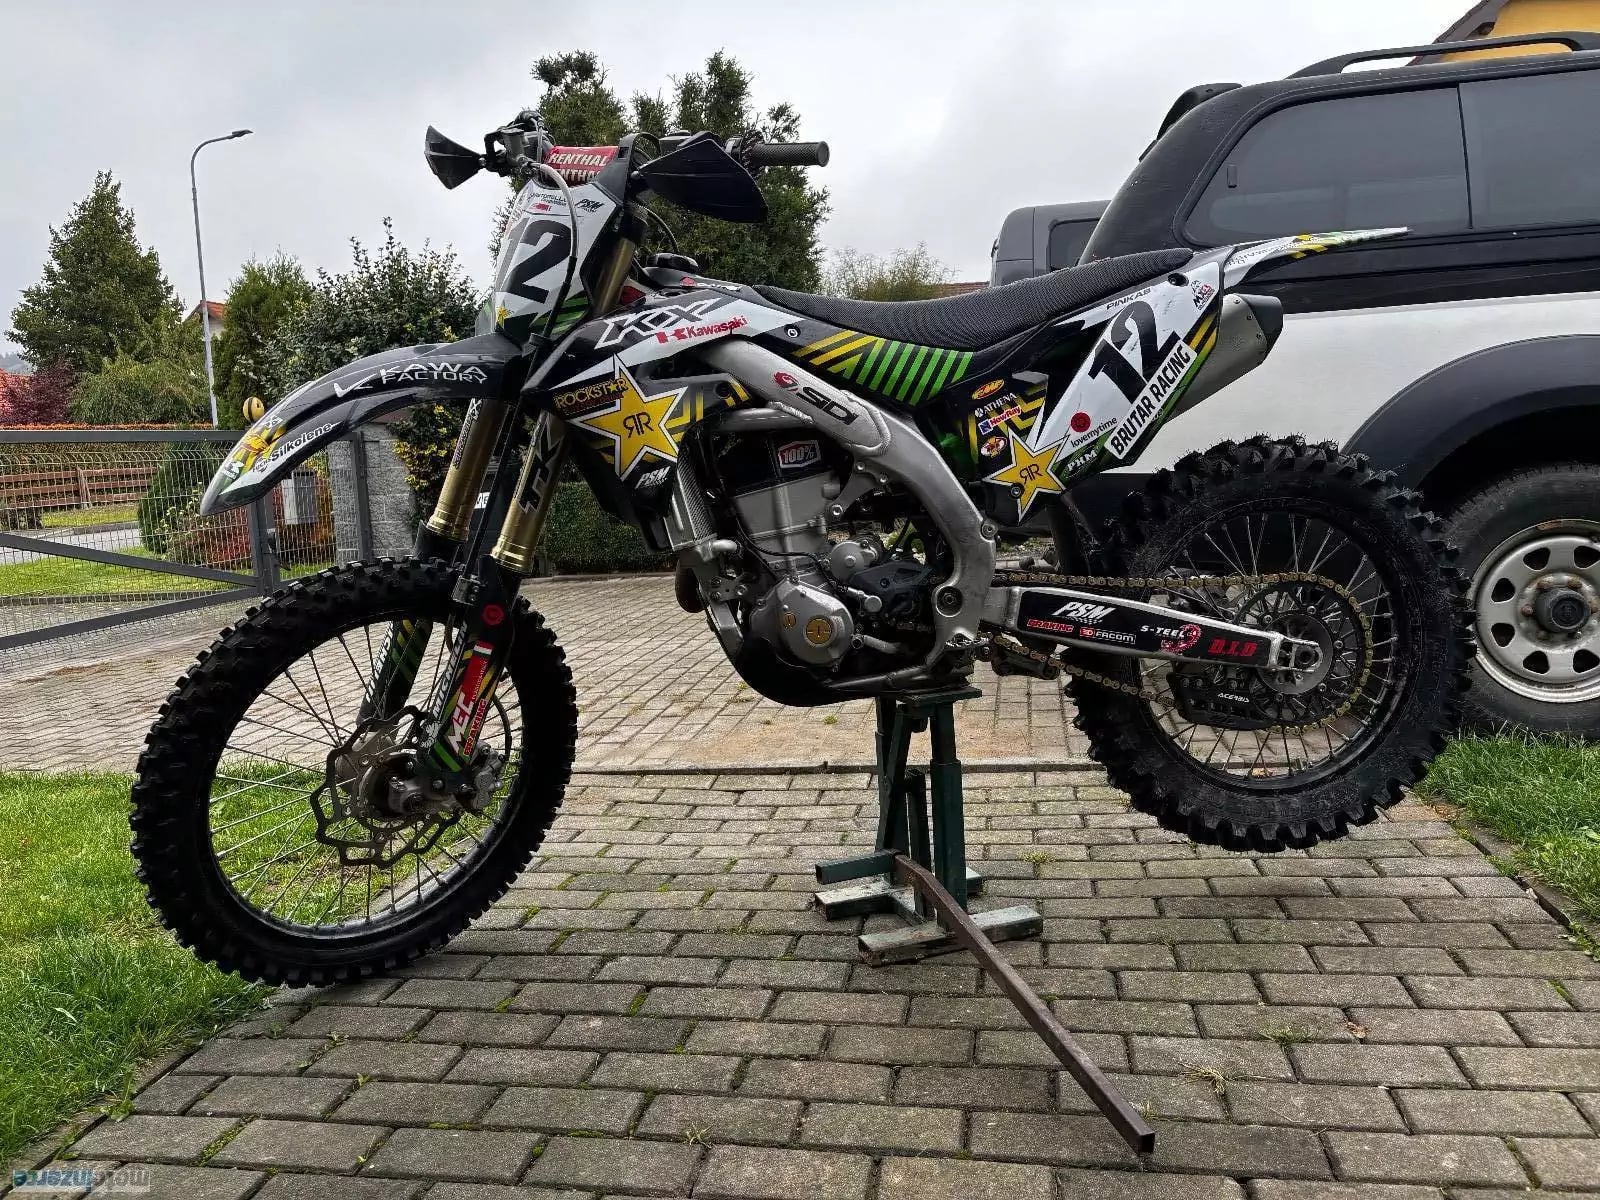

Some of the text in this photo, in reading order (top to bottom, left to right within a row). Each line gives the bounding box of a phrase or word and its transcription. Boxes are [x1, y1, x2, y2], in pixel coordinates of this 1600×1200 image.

[547, 153, 608, 167] RENTHAL
[686, 315, 748, 338] Kawasaki
[1088, 300, 1181, 404] 12
[380, 362, 488, 377] KAWA
[382, 370, 488, 384] FACTORY
[984, 392, 1017, 415] ATHENA
[1110, 343, 1191, 456] BRUTAR RACING
[271, 423, 333, 462] Silkolene
[1070, 416, 1118, 449] lovemytime
[784, 445, 818, 464] 100%
[1067, 449, 1097, 472] PHM
[634, 466, 671, 489] PSM
[1051, 601, 1117, 620] PSM
[1027, 618, 1074, 633] BRAKING
[1095, 631, 1134, 642] FACOM
[432, 619, 468, 719] MICHELIN
[1217, 692, 1250, 703] ACERBIS
[463, 698, 488, 757] BRAKING
